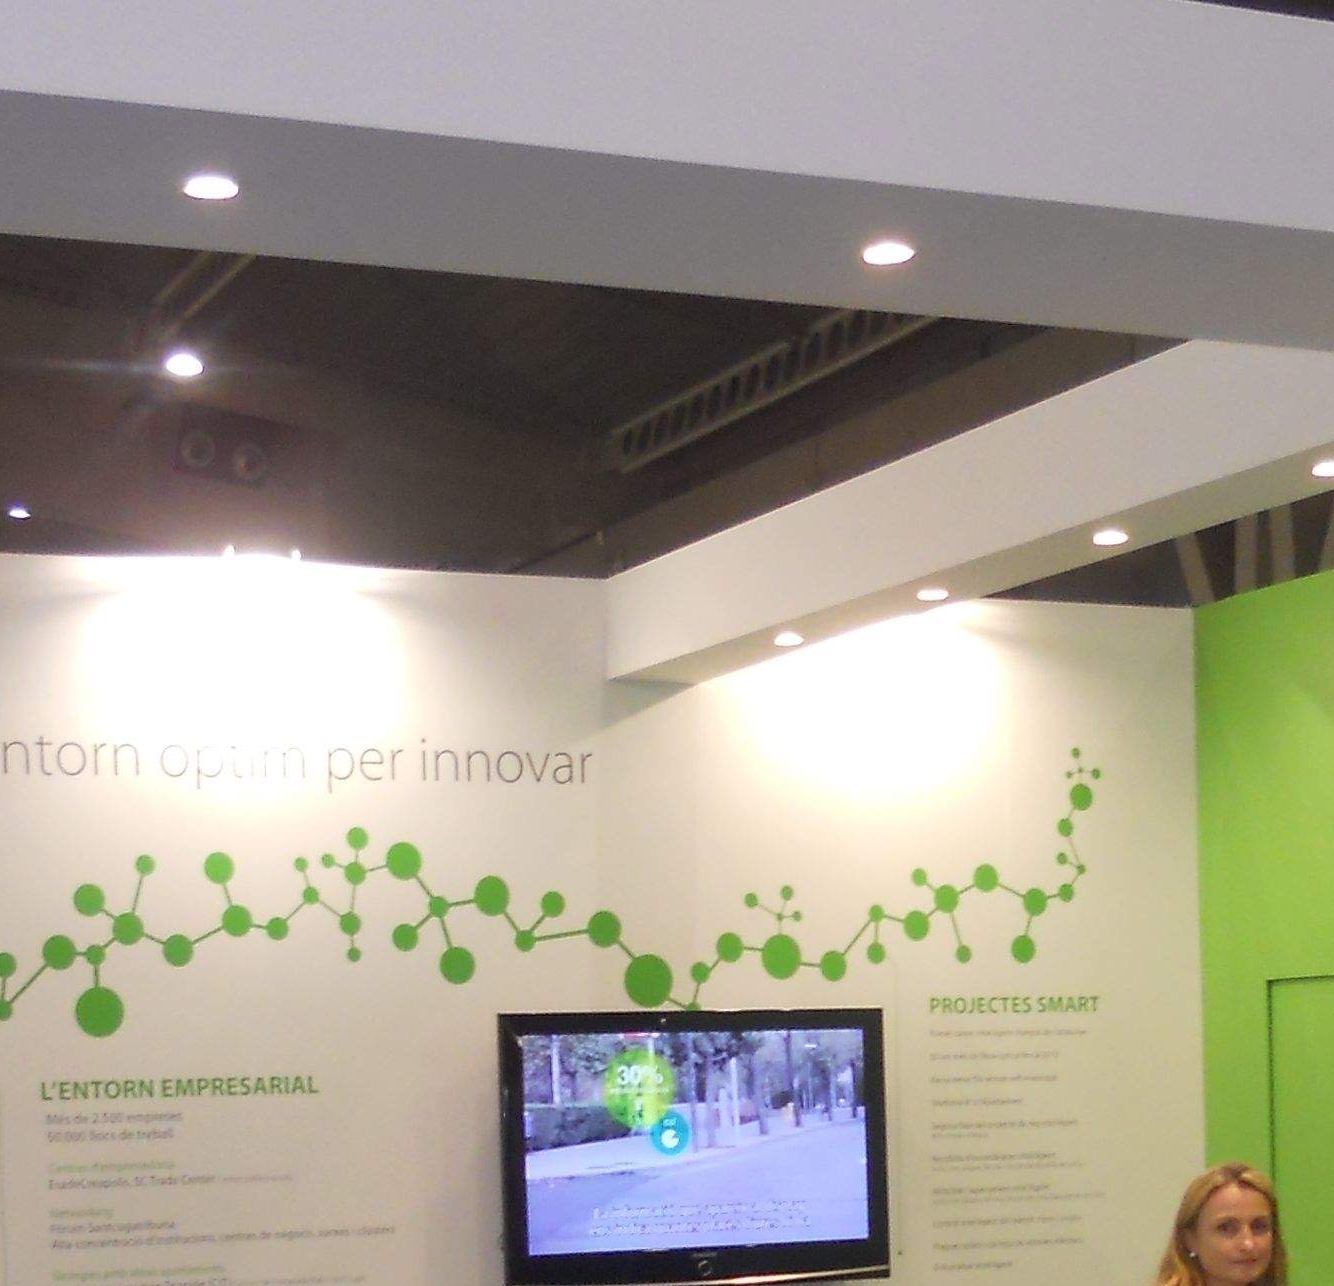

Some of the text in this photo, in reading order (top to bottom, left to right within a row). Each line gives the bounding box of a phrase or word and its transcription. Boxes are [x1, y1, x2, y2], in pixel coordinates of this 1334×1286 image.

[326, 744, 405, 793] per
[418, 738, 593, 785] innovar
[929, 995, 1100, 1014] PROJECTES SMART
[161, 1075, 319, 1098] EMPRESARIAL
